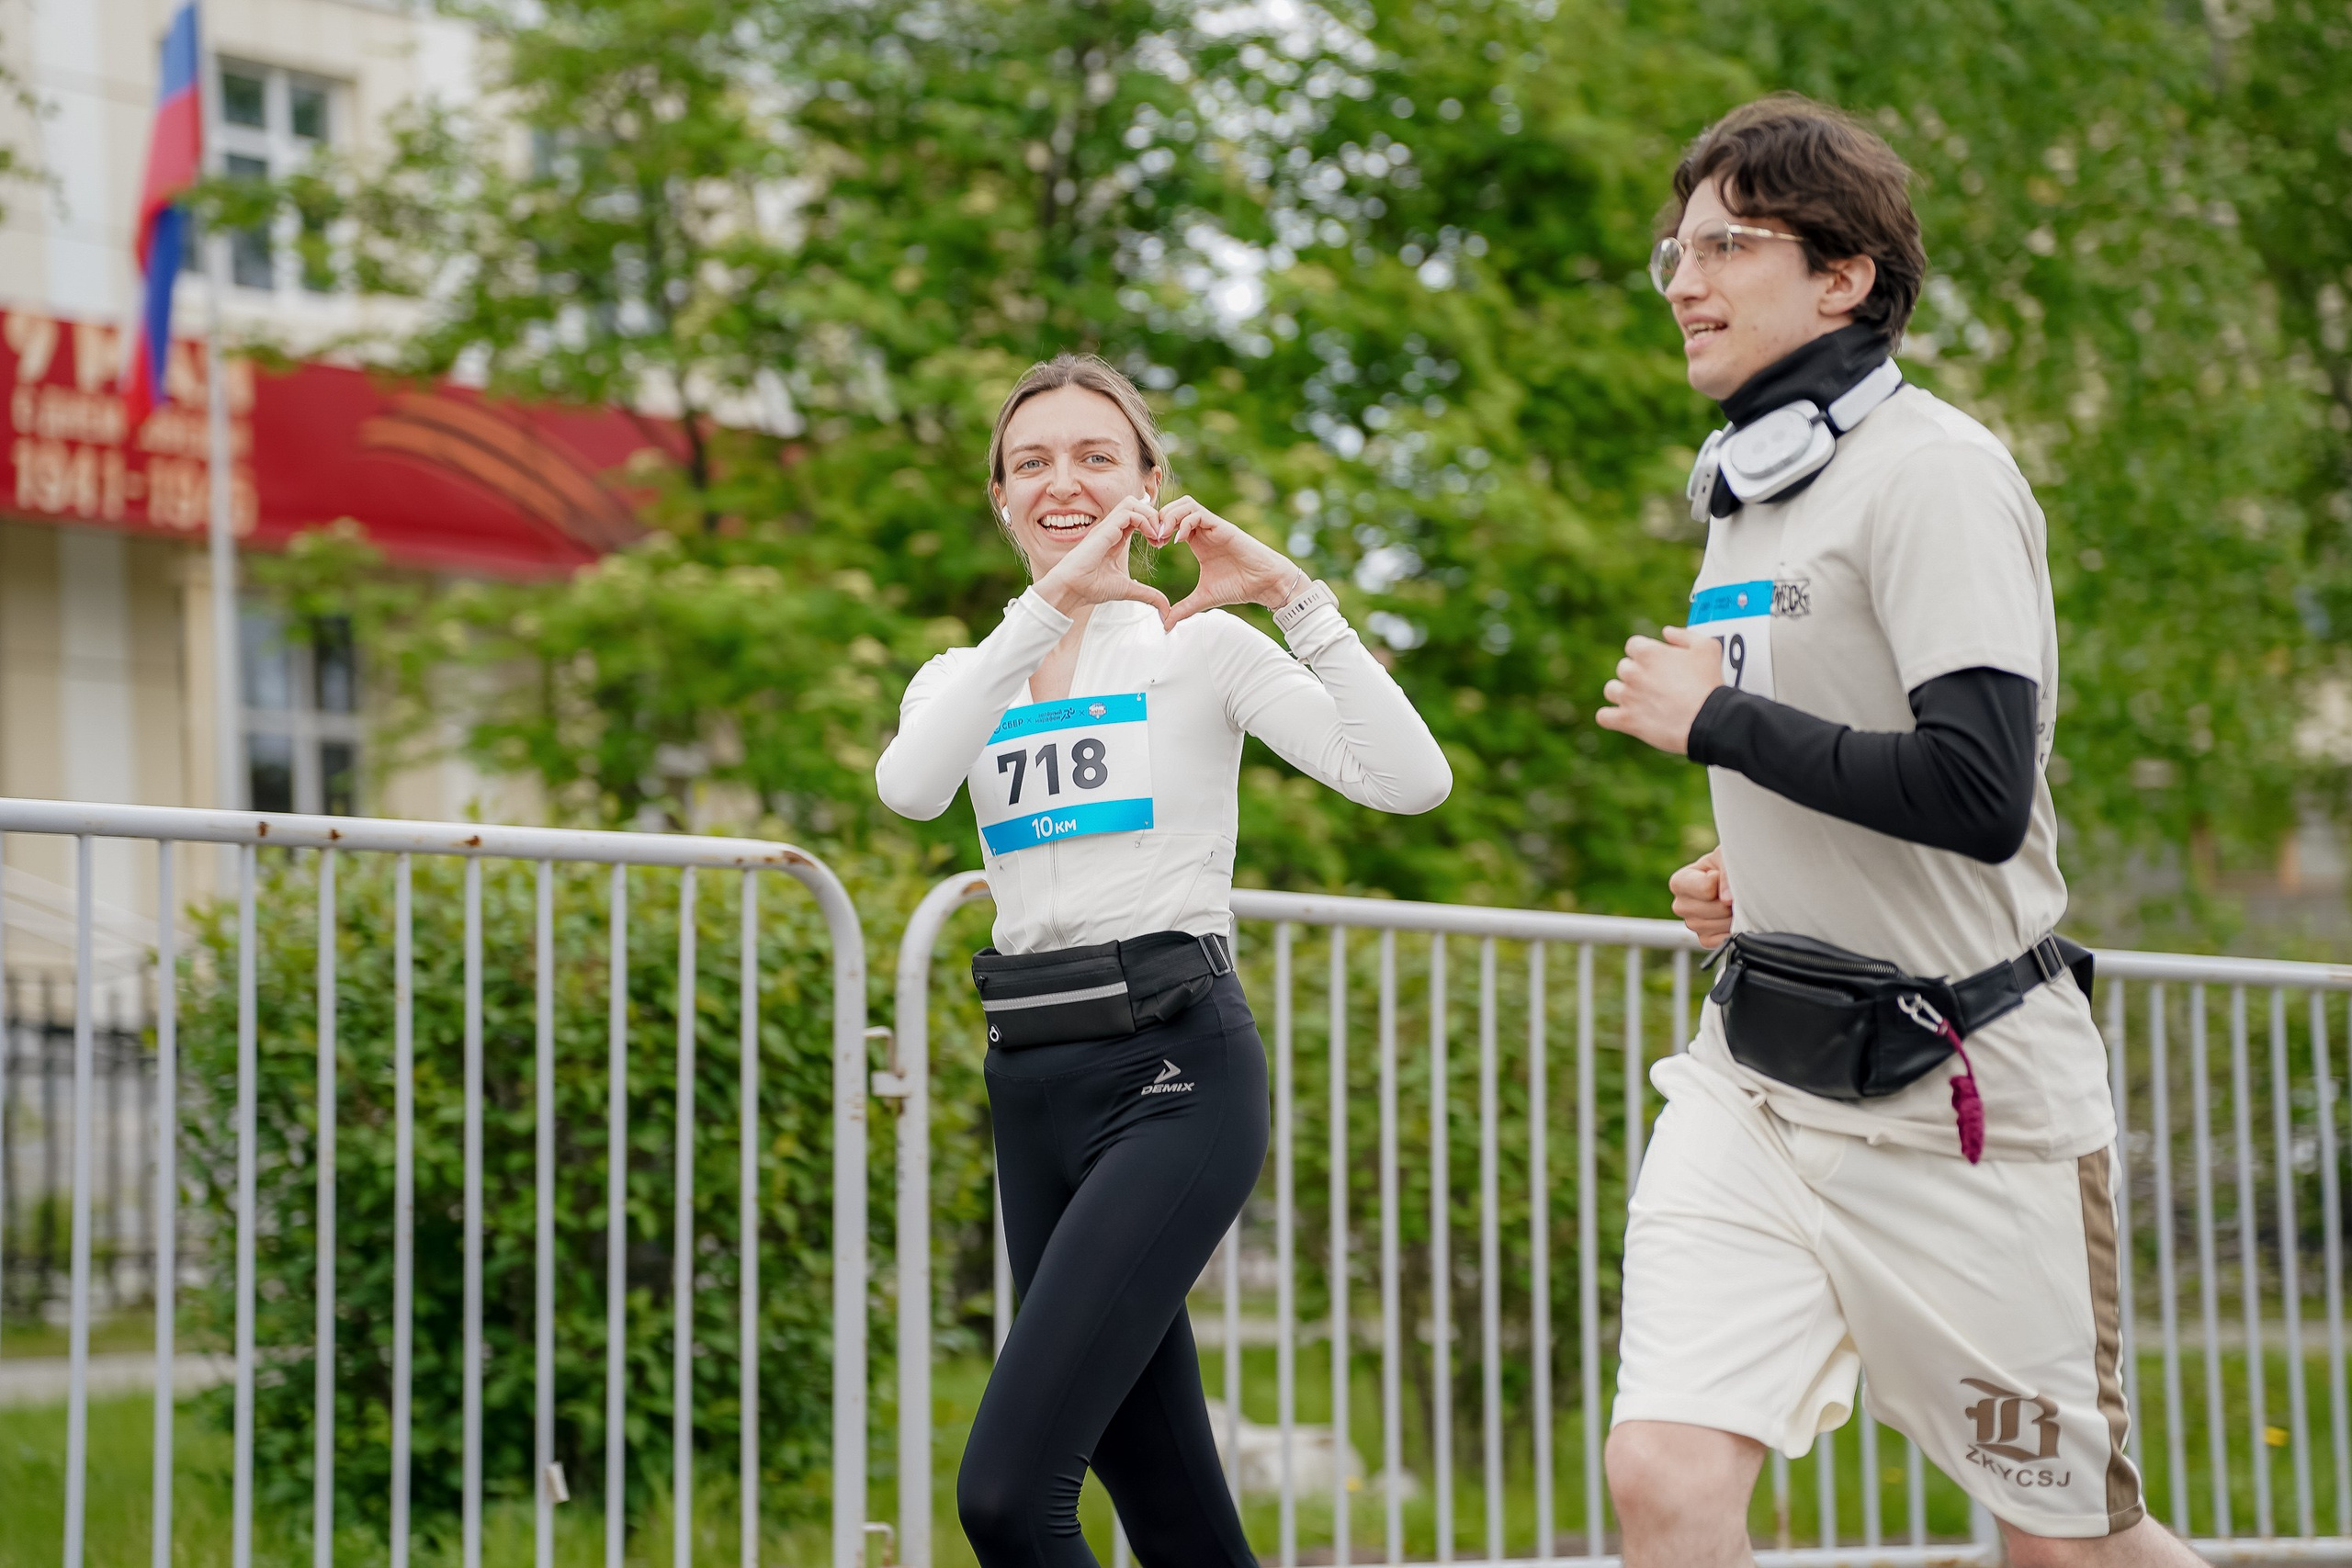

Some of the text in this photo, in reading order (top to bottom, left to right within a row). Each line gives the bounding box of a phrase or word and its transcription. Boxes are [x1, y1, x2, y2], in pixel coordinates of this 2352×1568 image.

[1711, 633, 1745, 688] 9
[1001, 717, 1023, 731] СБЕР
[997, 739, 1108, 806] 718
[1140, 1081, 1195, 1096] DEMIX
[1965, 1443, 2072, 1488] ZKYCSJ
